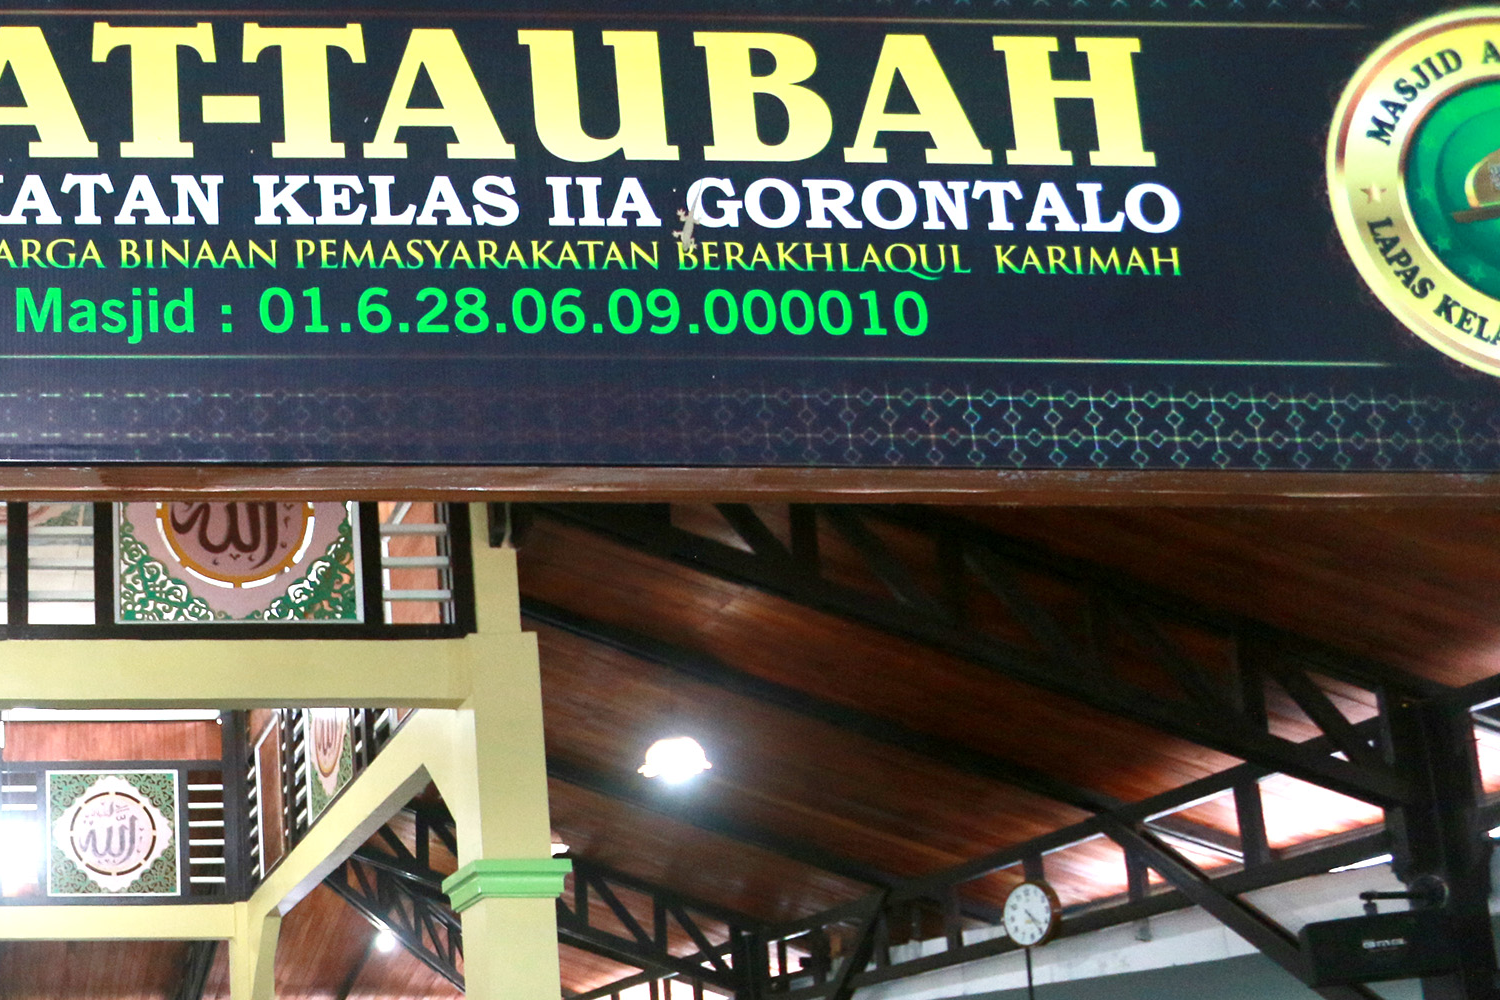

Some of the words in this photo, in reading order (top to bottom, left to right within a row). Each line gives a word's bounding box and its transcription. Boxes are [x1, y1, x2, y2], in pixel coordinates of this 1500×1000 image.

[1366, 48, 1463, 146] MASJID
[253, 175, 520, 227] KELAS
[546, 176, 662, 228] IIA
[685, 177, 1182, 234] GORONTALO
[118, 239, 278, 271] BINAAN
[295, 239, 660, 271] PEMASYARAKATAN
[676, 241, 972, 280] BERAKHLAQUL
[994, 244, 1182, 276] KARIMAH
[1367, 217, 1436, 299] LAPAS
[16, 286, 195, 345] Masjid
[221, 304, 233, 333] :
[259, 286, 929, 337] 01.6.28.06.09.000010
